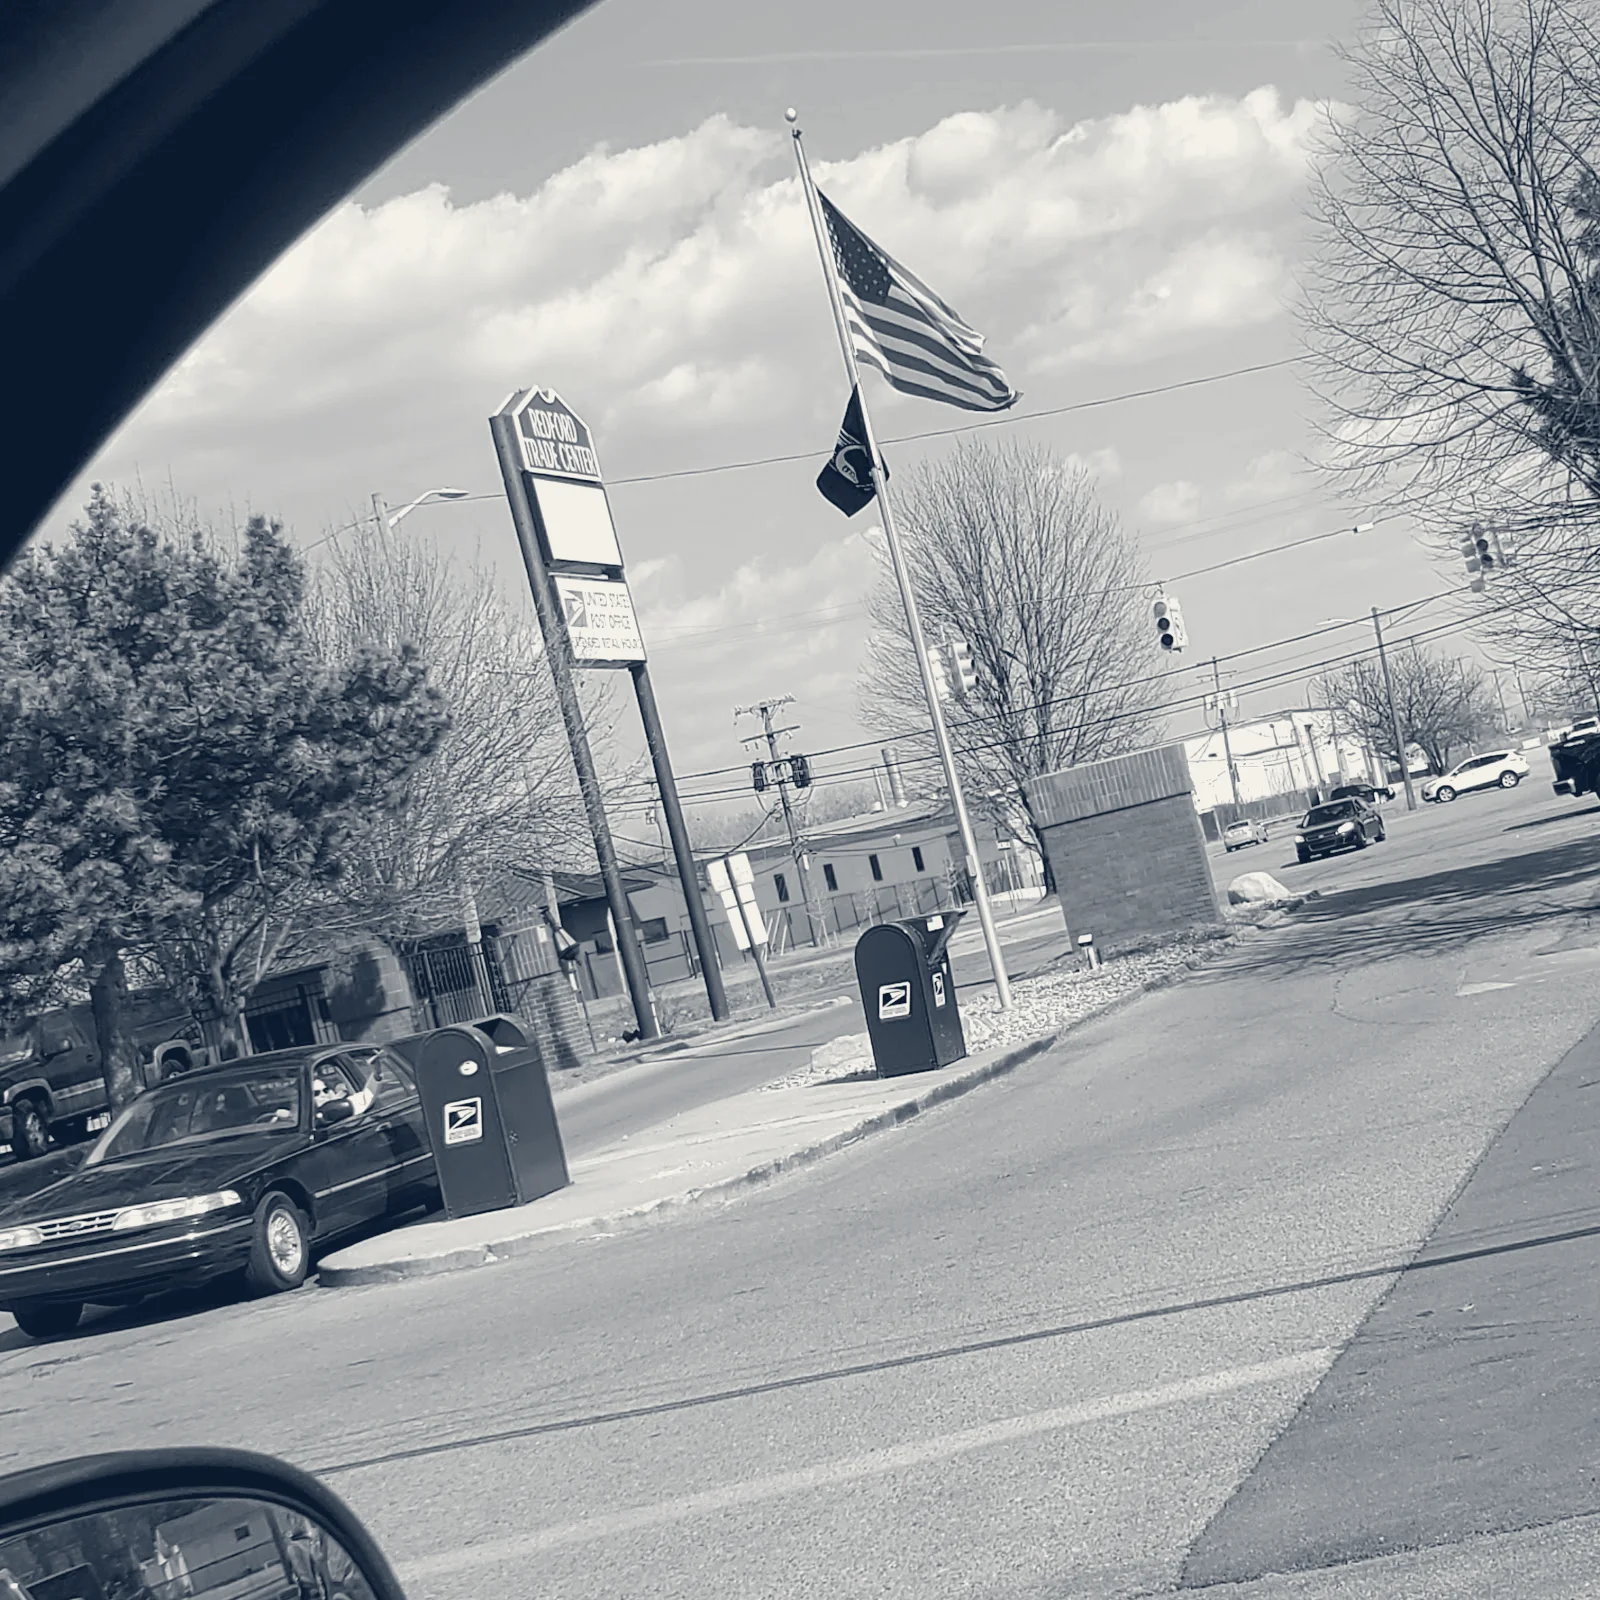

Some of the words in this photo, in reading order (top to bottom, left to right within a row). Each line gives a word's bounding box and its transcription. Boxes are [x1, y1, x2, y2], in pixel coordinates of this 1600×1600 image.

[528, 407, 578, 444] REDFORD
[524, 438, 562, 470] TRADE
[558, 442, 598, 476] CENTER
